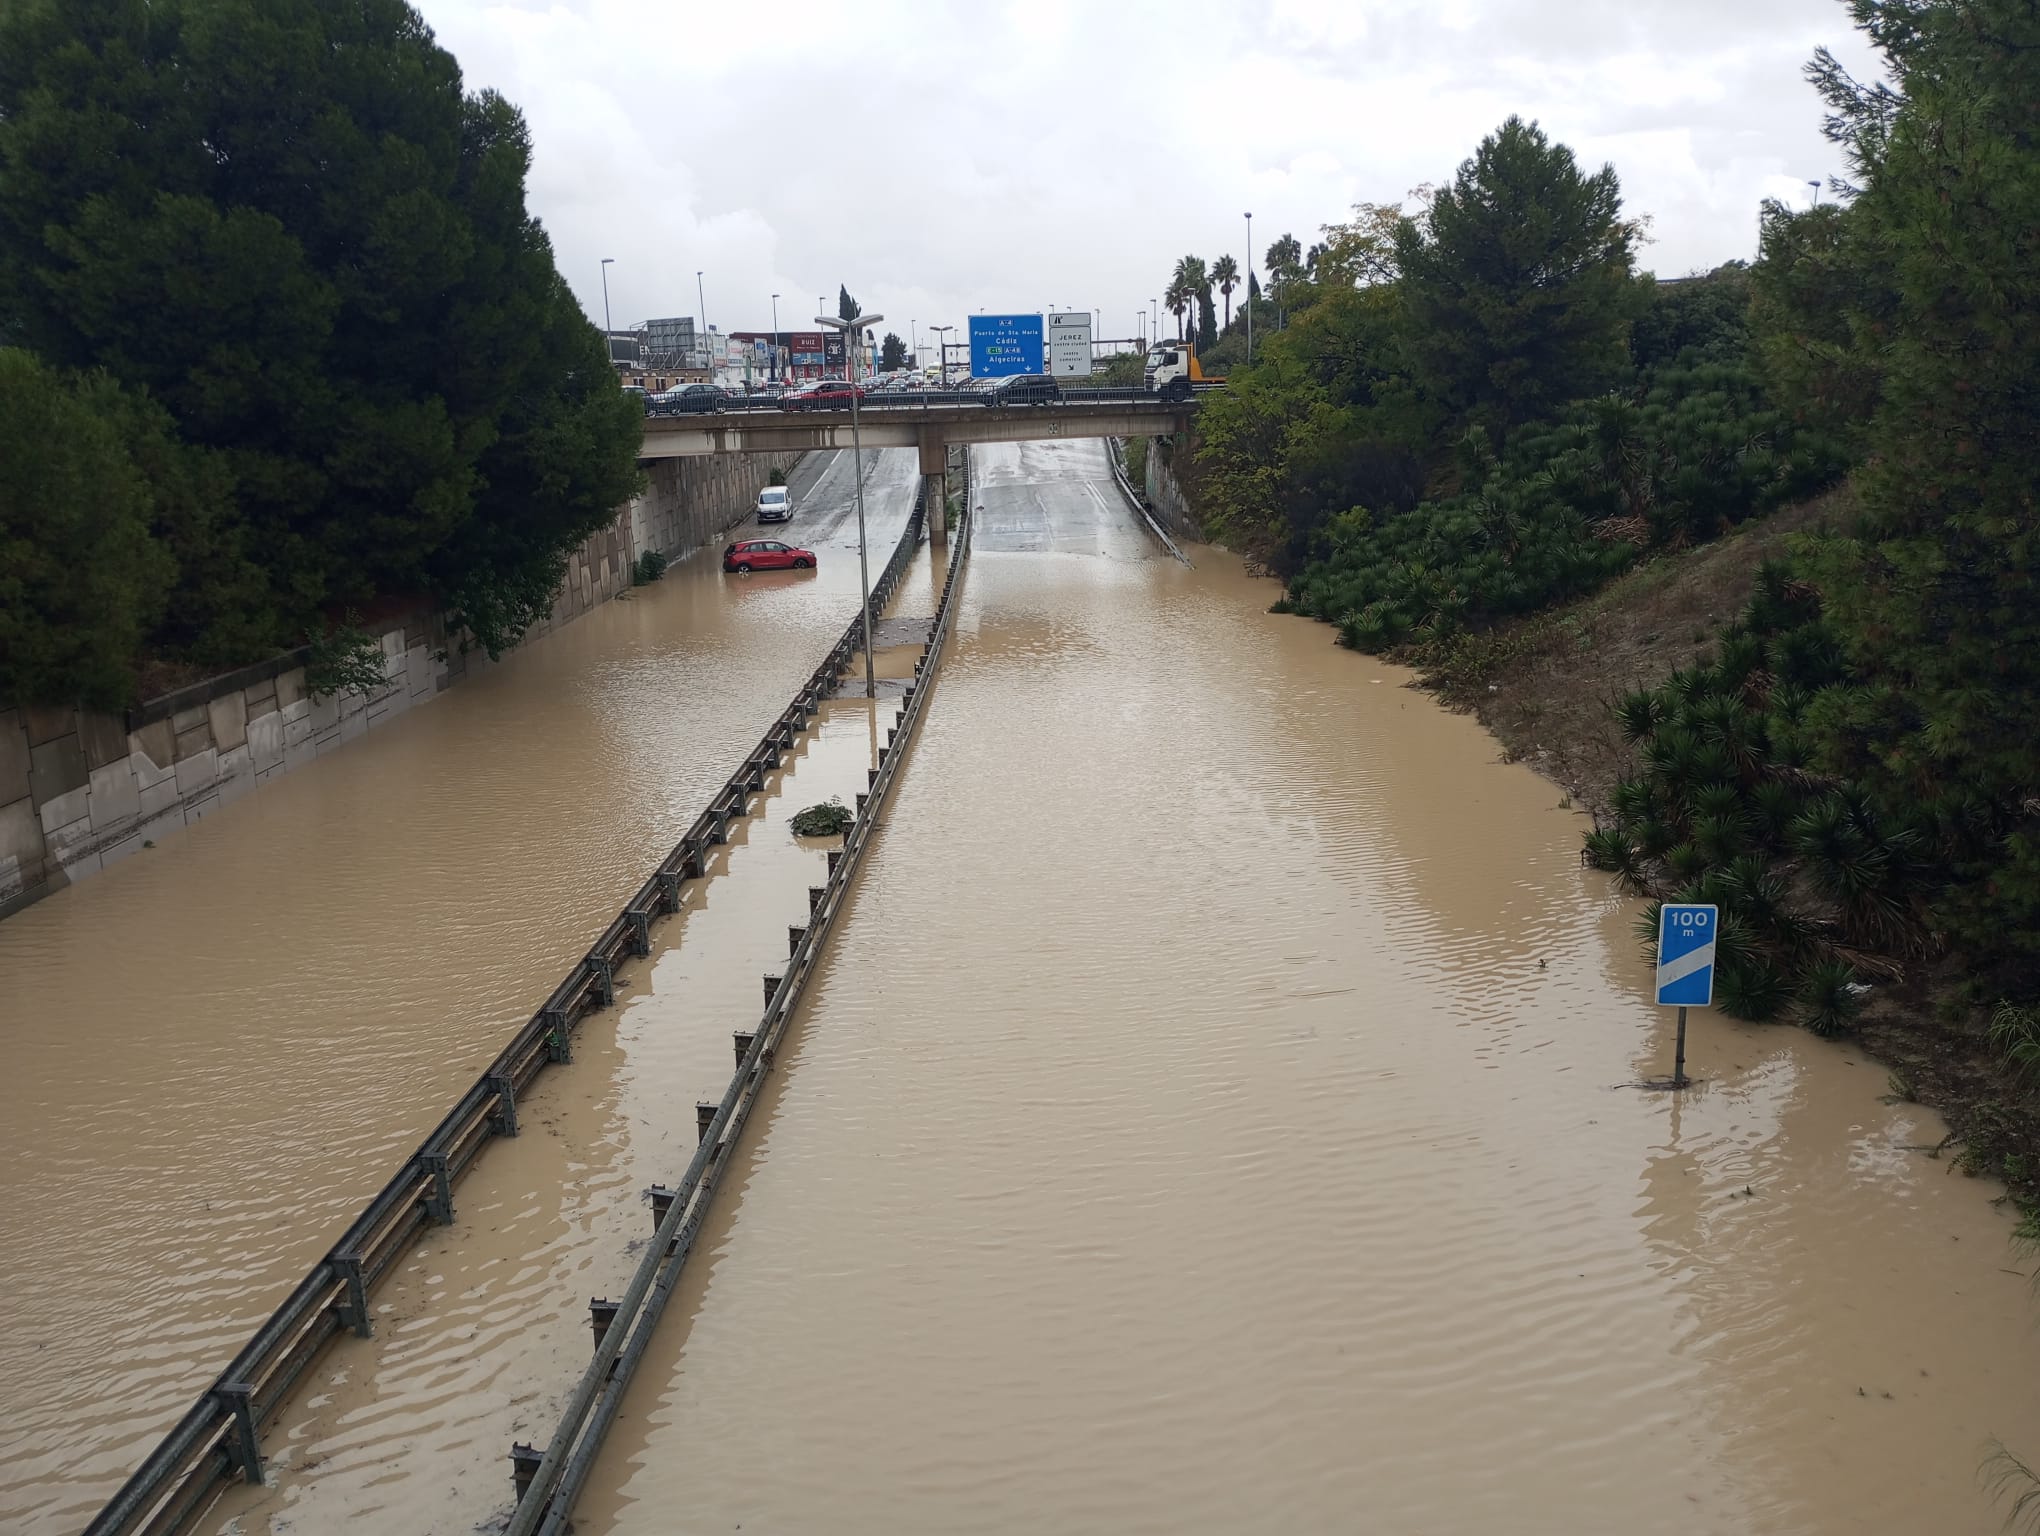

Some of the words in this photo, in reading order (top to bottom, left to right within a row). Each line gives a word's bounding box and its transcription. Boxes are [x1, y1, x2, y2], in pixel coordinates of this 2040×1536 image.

[989, 356, 1025, 364] Algeciras
[1671, 912, 1708, 927] 100
[1683, 929, 1694, 937] m
